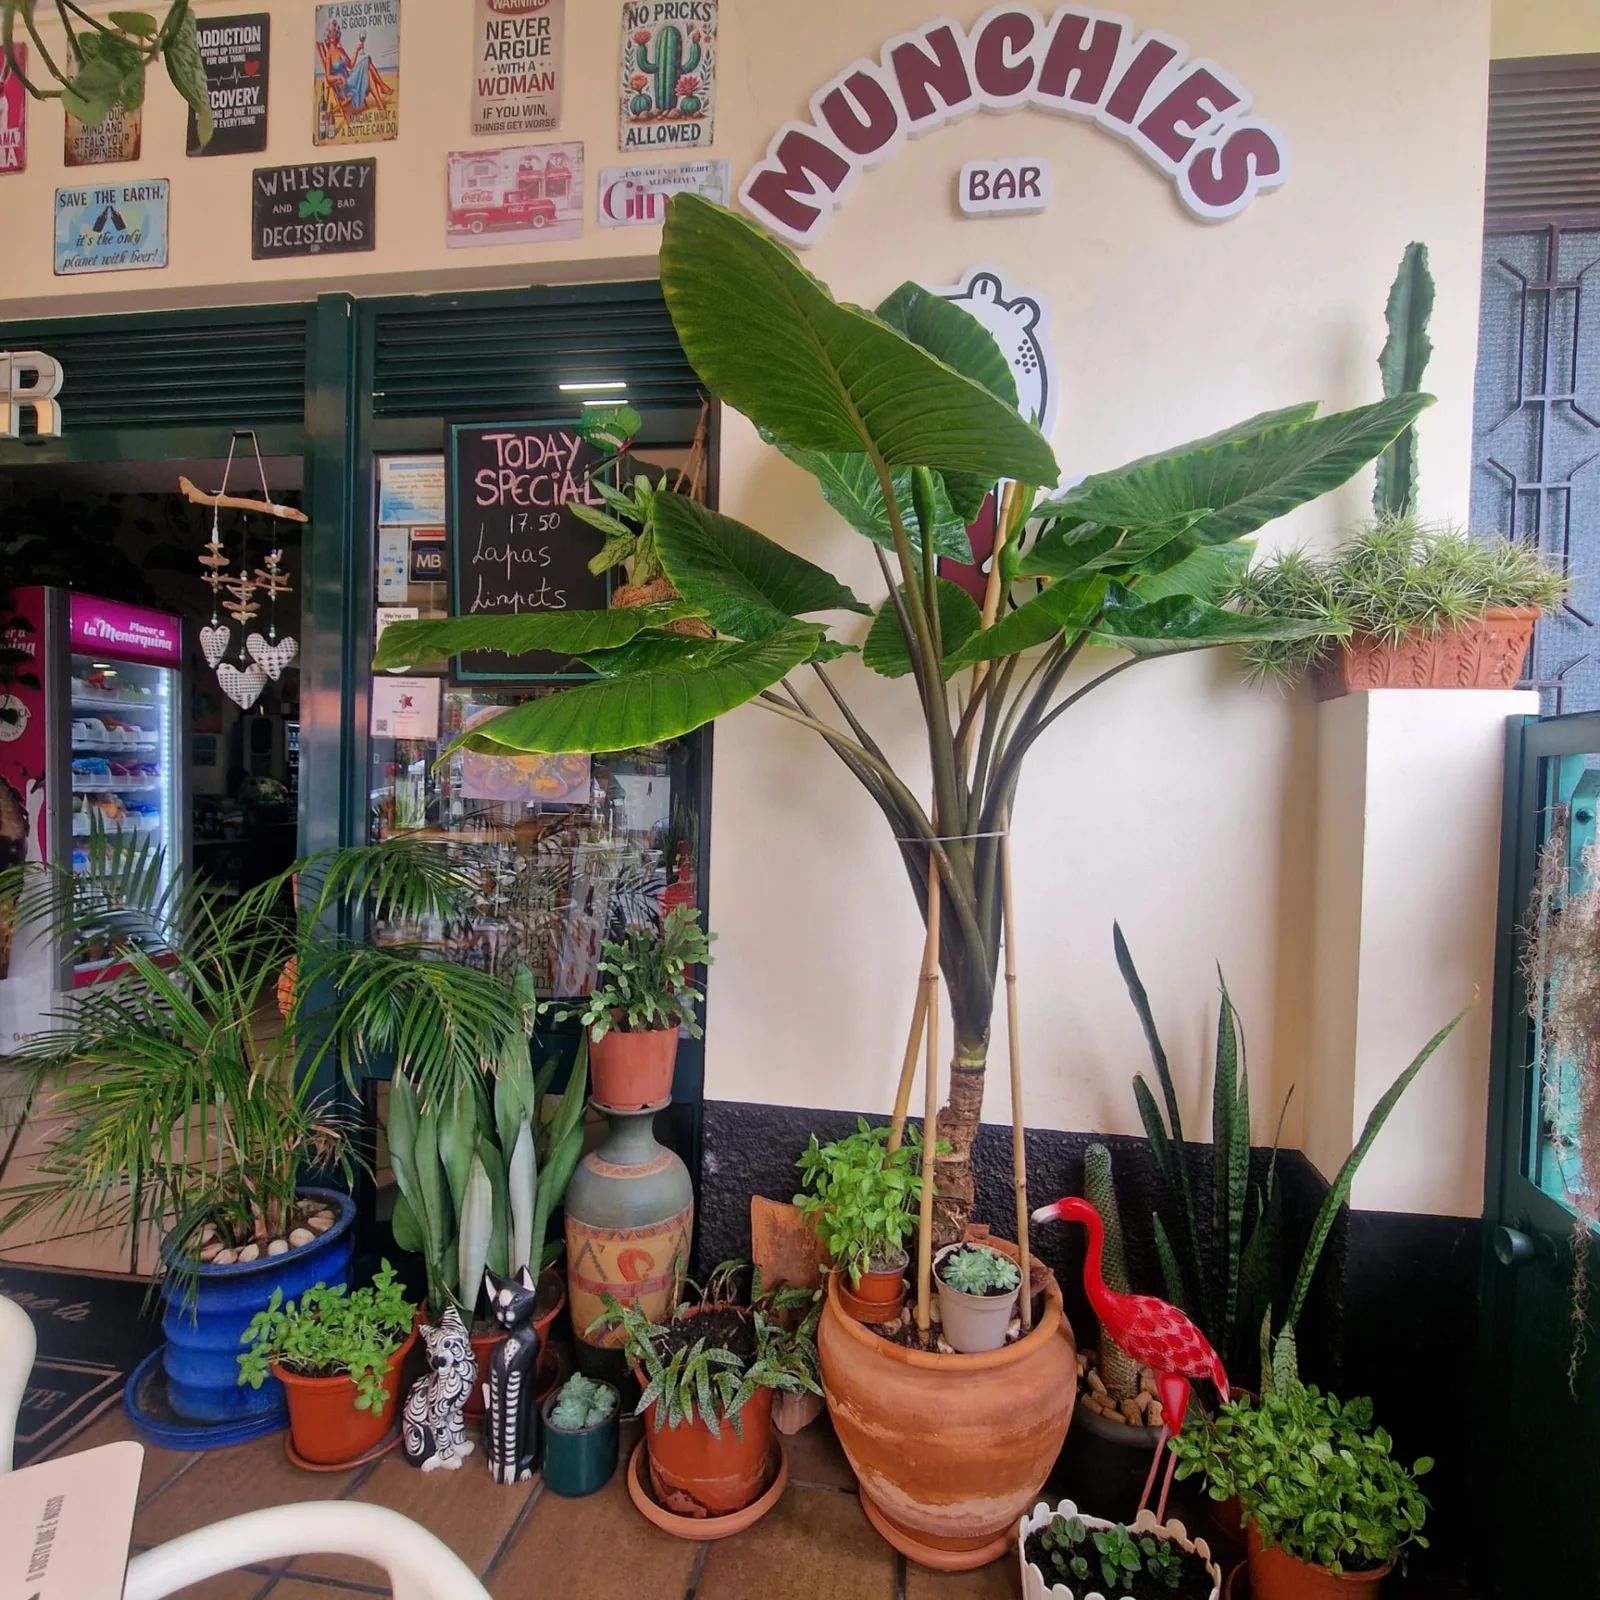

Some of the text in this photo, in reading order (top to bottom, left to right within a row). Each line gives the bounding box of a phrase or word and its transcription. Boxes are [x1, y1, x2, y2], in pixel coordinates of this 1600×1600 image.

[341, 4, 362, 16] GLASS
[364, 3, 372, 14] OF
[374, 1, 390, 13] WINE
[628, 1, 712, 29] NO PRICKS
[341, 18, 348, 29] IS
[349, 16, 367, 28] GOOD
[369, 15, 381, 26] FOR
[486, 17, 551, 40] NEVER
[195, 26, 261, 48] ADDICTION
[201, 44, 261, 57] GIVING UP EVERYTHING
[484, 37, 551, 60] ARGUE
[206, 55, 217, 65] FOR
[497, 60, 536, 75] WITH A
[478, 71, 555, 97] WOMAN
[208, 86, 260, 109] COVERY
[483, 103, 548, 119] IF YOU WIN,
[748, 12, 1281, 232] MUNCHIES
[105, 122, 123, 133] AND
[347, 124, 370, 137] BOTTLE
[372, 122, 385, 134] CAN
[474, 118, 556, 132] THINGS GET WORSE
[626, 123, 701, 146] ALLOWED
[74, 133, 130, 150] STEALS YOUR
[258, 165, 370, 196] WHISKEY
[969, 166, 1041, 200] BAR
[60, 186, 164, 207] SAVE THE EARTH.
[273, 198, 356, 214] AND BAD
[76, 229, 142, 247] it's the only
[263, 220, 364, 248] DECISIONS
[63, 248, 159, 271] planet with beer!
[481, 432, 582, 470] TODAY
[510, 512, 561, 534] 17.50
[416, 554, 442, 568] MB
[472, 522, 551, 581] Lapas
[470, 575, 567, 614] Limpets
[96, 617, 173, 651] Menorquina
[129, 622, 157, 635] Placer
